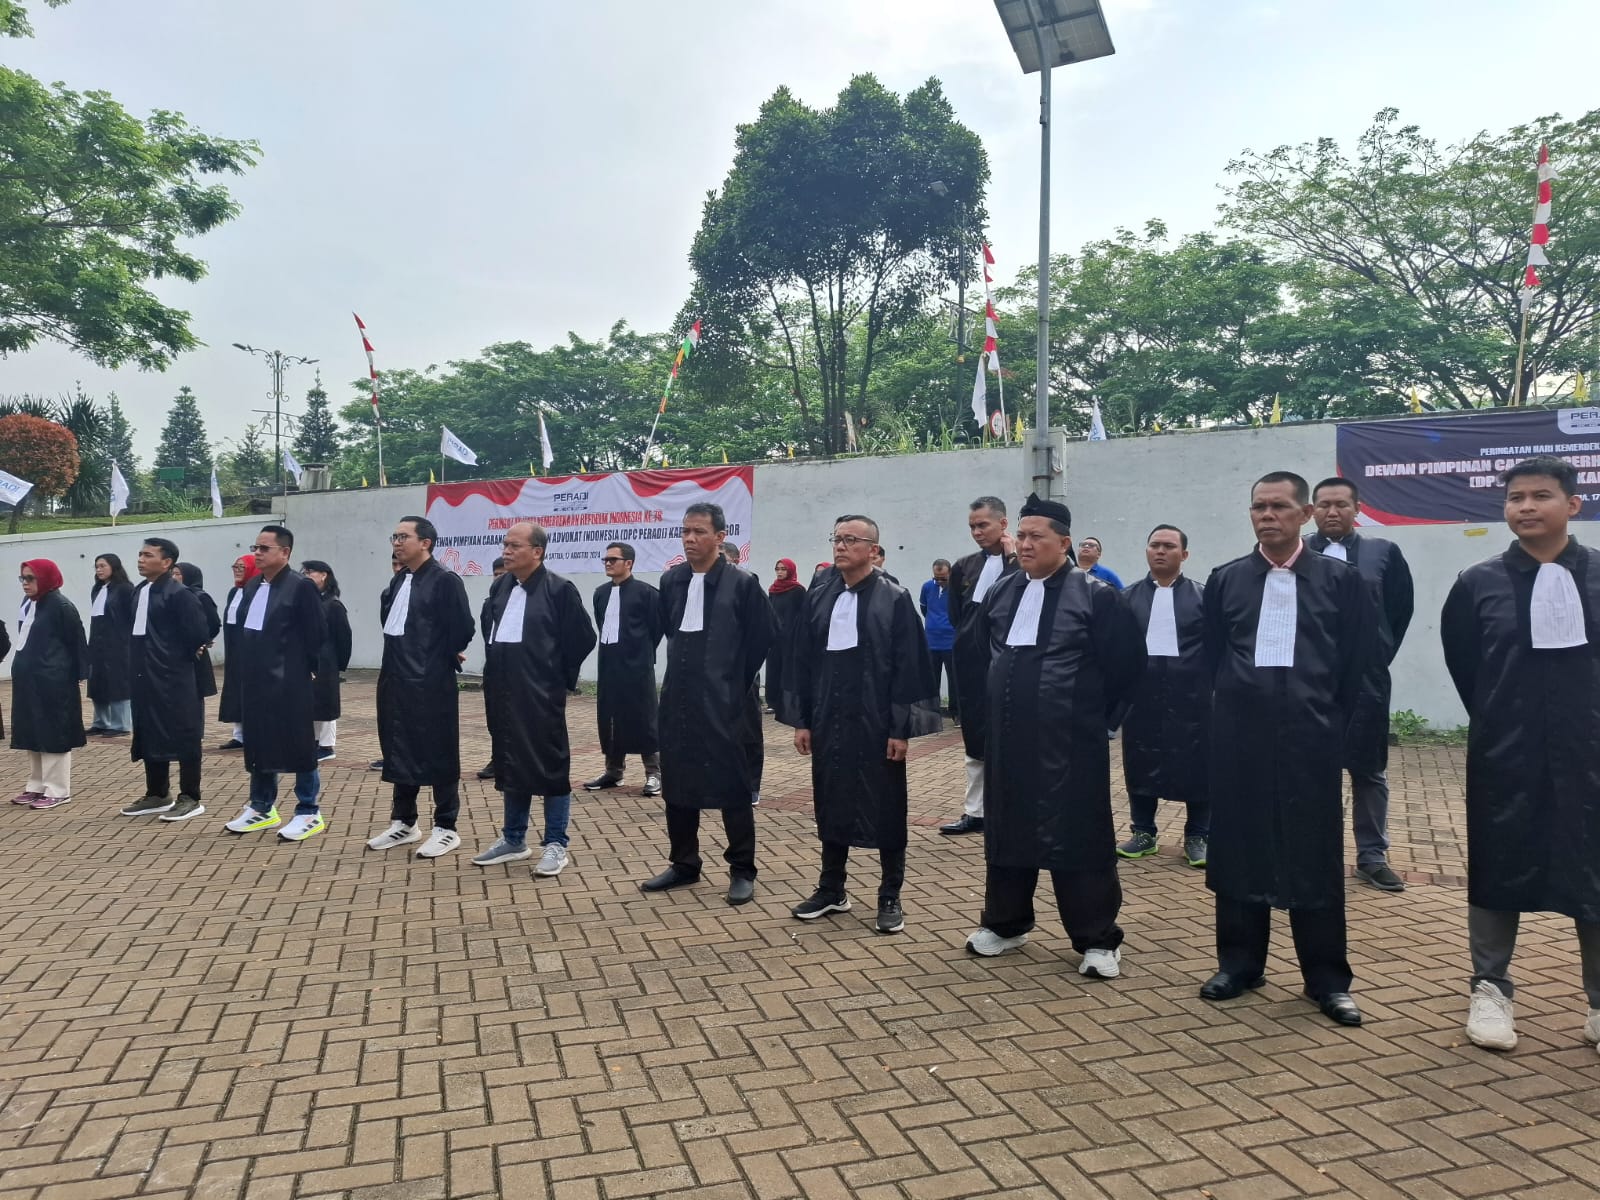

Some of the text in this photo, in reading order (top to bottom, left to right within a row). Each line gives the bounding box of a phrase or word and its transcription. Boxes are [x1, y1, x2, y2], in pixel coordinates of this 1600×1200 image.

[1570, 411, 1600, 420] PER
[1480, 446, 1532, 456] PERINGATAN
[1533, 445, 1554, 453] HARI
[1364, 464, 1416, 477] DEWAN
[1418, 459, 1492, 475] PIMPINAN
[553, 491, 589, 502] PERADI
[609, 511, 643, 524] INDONESIA
[453, 535, 482, 547] PIMPINAN
[551, 531, 582, 543] ADVOKAT
[583, 528, 619, 542] INDONESIA
[638, 527, 668, 540] PERADI)
